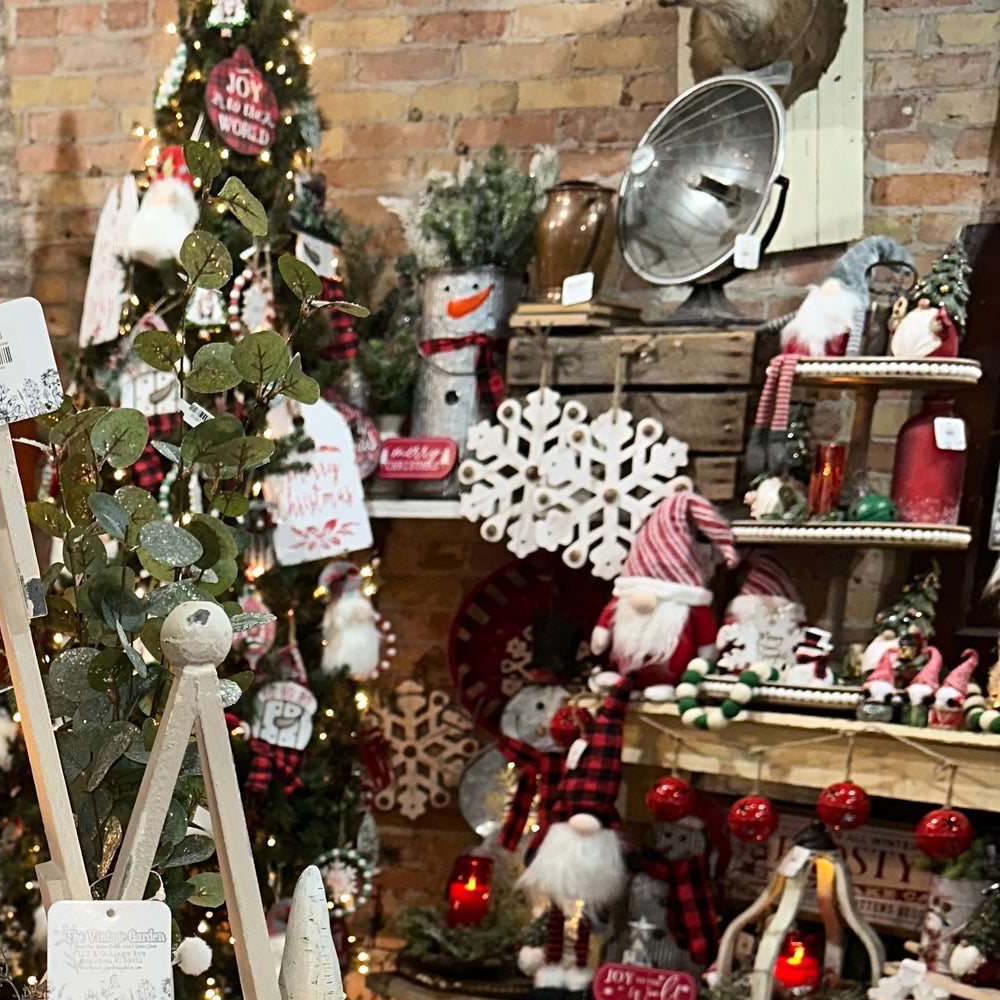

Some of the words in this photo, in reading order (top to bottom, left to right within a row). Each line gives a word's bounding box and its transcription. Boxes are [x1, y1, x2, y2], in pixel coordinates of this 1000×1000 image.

[226, 73, 263, 103] JOY
[218, 112, 270, 146] WORLD
[65, 928, 86, 944] The
[128, 928, 167, 943] Garden
[604, 969, 633, 986] JOY
